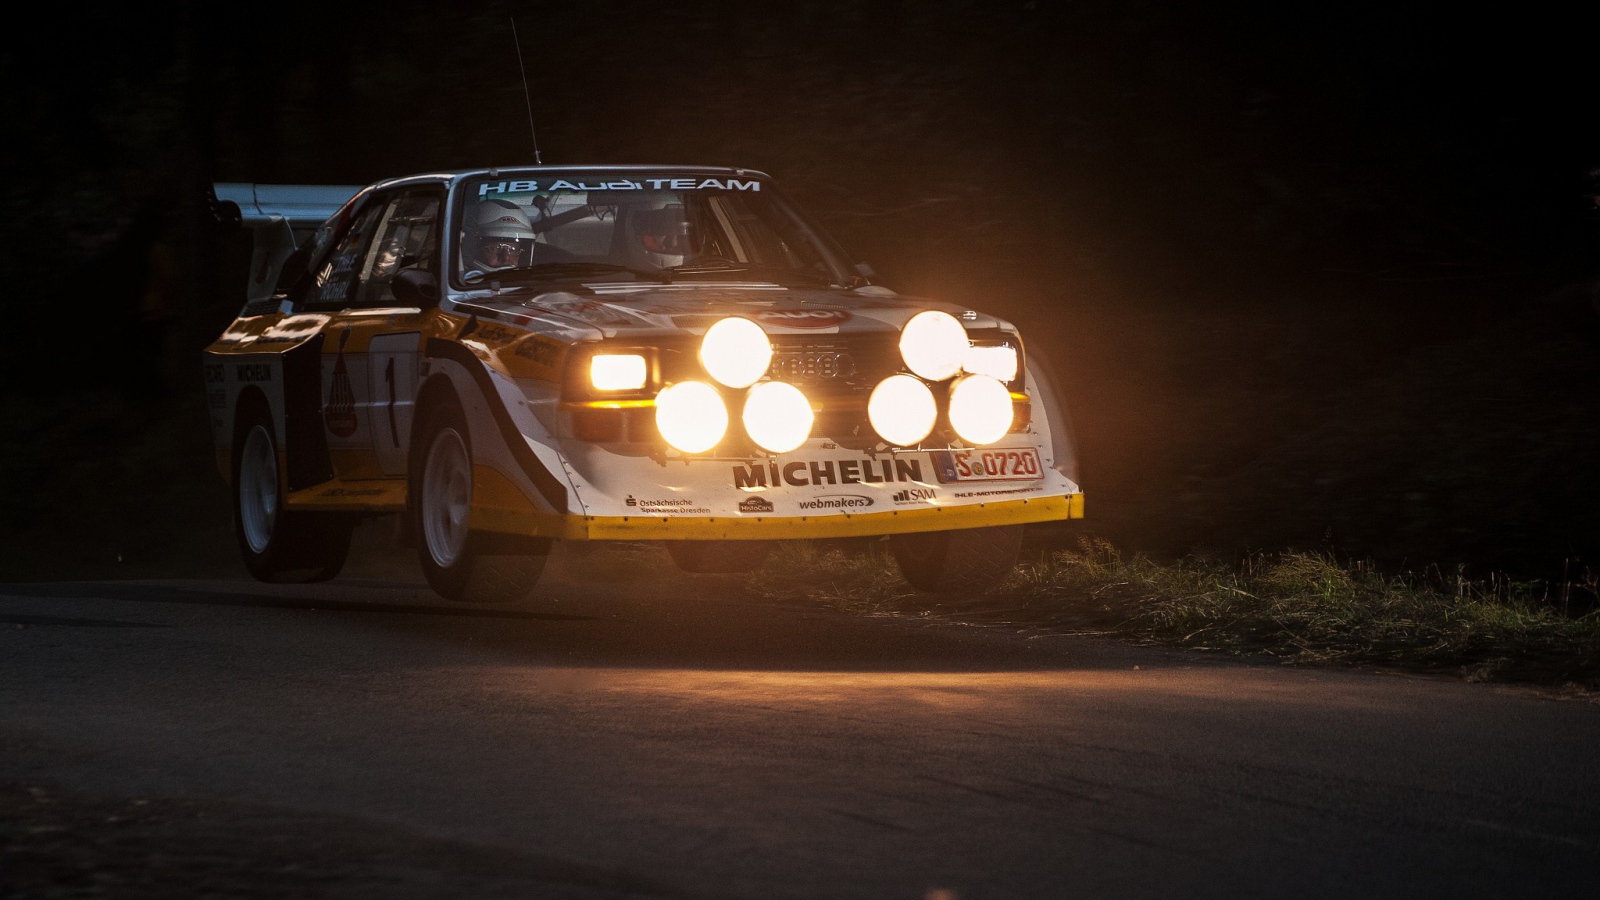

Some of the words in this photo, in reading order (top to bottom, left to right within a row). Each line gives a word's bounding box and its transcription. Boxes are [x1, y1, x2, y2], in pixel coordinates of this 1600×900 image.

[478, 180, 538, 196] HB
[646, 178, 761, 192] TEAM
[237, 364, 271, 382] MICHELIN
[385, 357, 400, 449] 1
[955, 452, 973, 477] S
[981, 452, 1038, 477] 0720
[732, 459, 923, 489] MICHELIN
[639, 499, 693, 507] Ostsächsische
[799, 497, 865, 509] webmakers
[910, 488, 937, 501] SAM
[679, 506, 711, 514] Dresden
